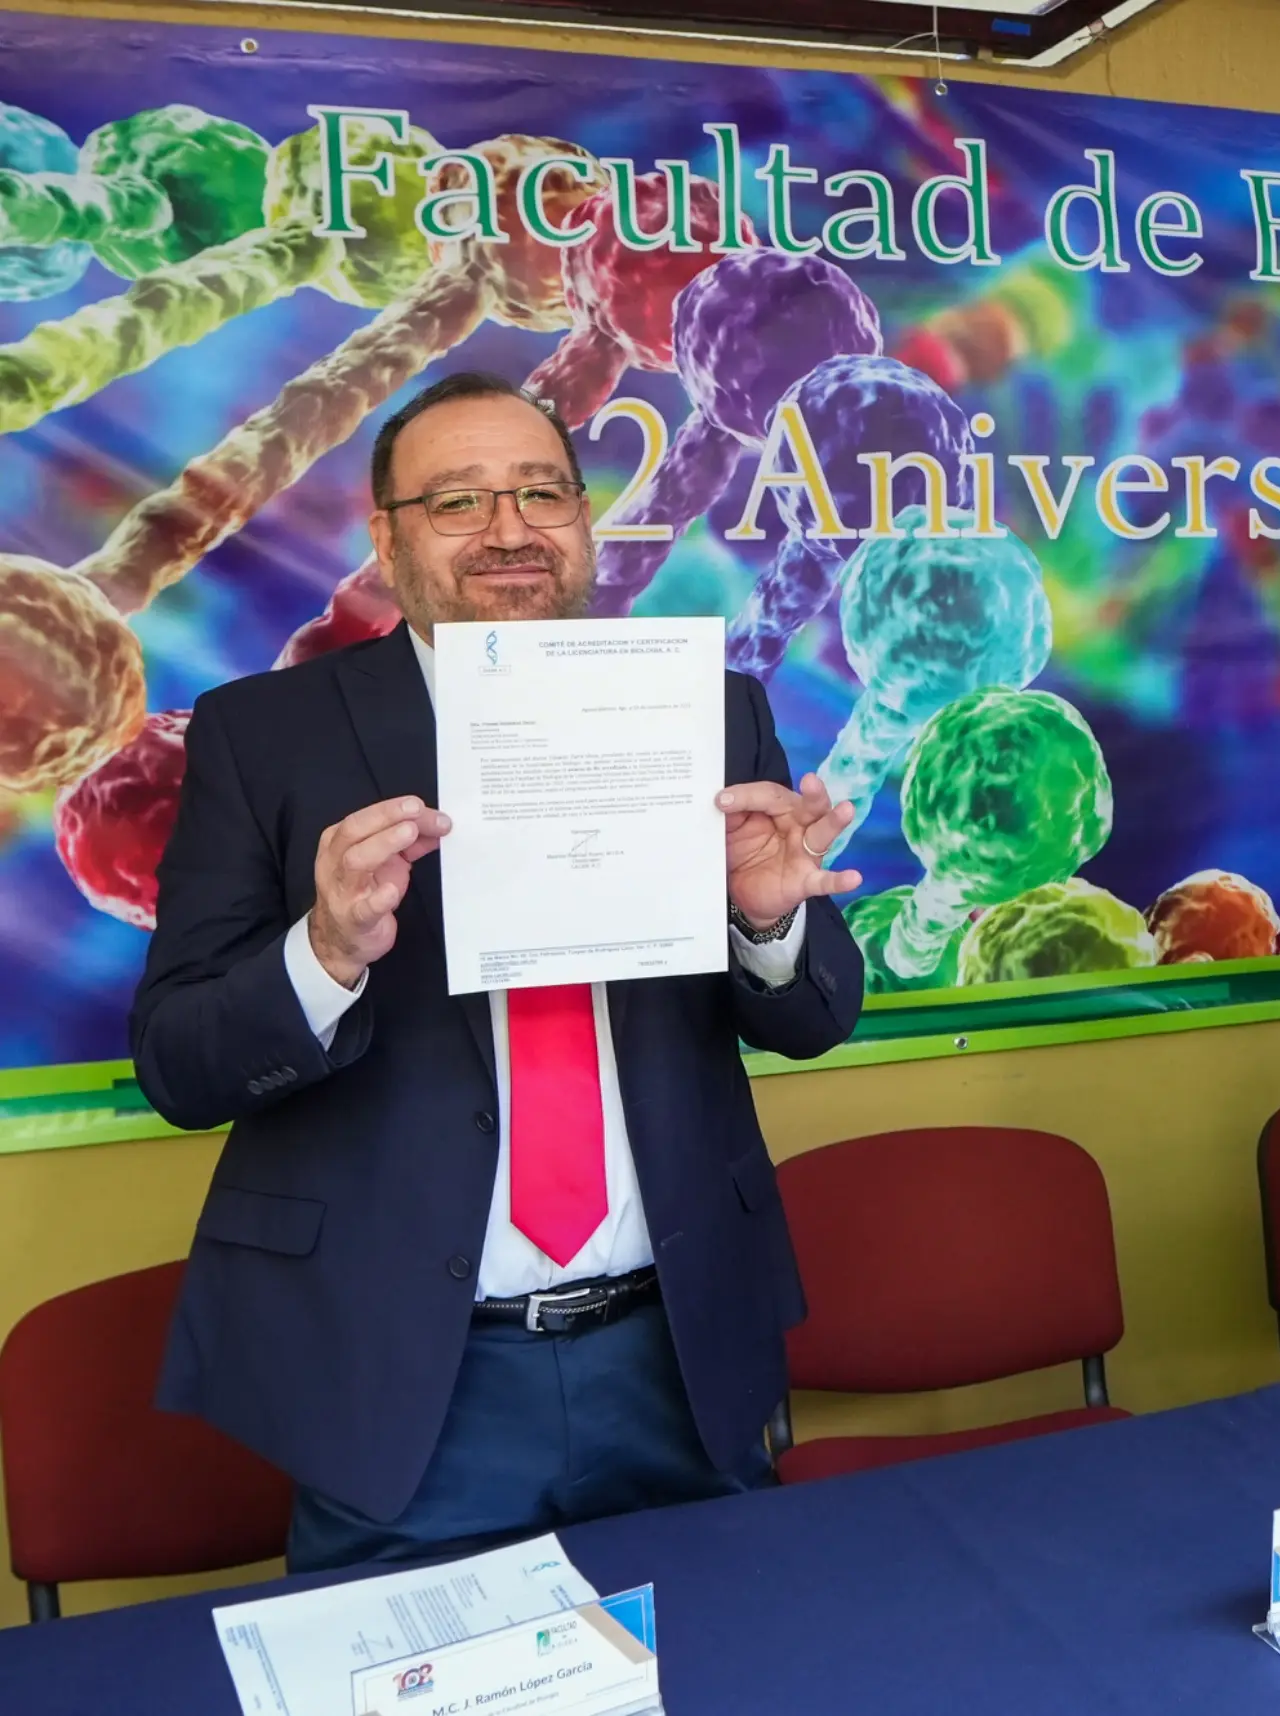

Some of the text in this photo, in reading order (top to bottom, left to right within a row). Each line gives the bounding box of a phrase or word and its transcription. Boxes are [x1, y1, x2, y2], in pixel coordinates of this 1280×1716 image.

[308, 105, 1001, 265] Facultad
[1046, 150, 1204, 276] de
[475, 1687, 517, 1706] Ramón
[519, 1673, 554, 1694] López
[556, 1660, 594, 1681] García
